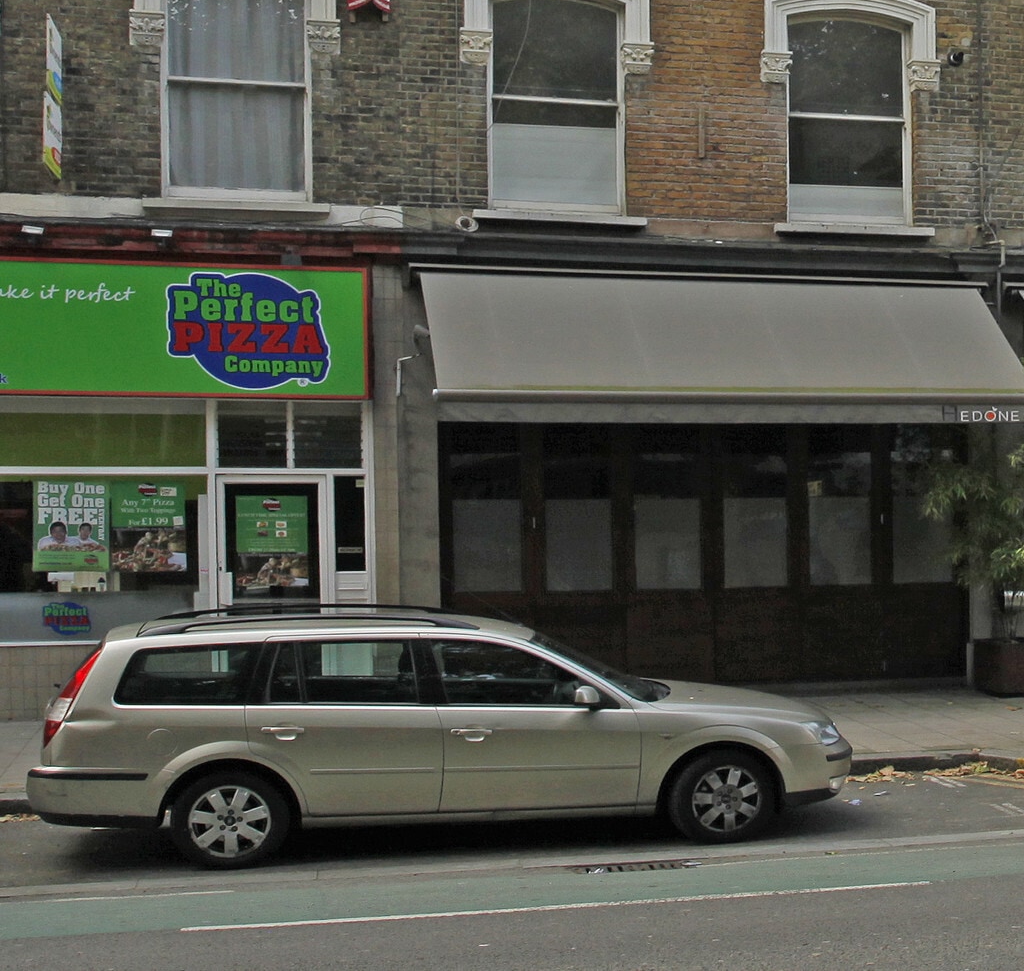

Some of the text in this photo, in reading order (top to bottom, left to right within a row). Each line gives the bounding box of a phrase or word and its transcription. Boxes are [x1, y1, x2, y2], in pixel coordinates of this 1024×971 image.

[40, 284, 59, 299] it
[65, 282, 136, 303] perfect
[196, 278, 242, 297] The
[173, 290, 315, 323] Perfect
[173, 322, 324, 354] PIZZA
[224, 355, 324, 377] Company
[37, 481, 105, 494] Buy One
[37, 494, 105, 508] Get One
[121, 499, 139, 508] Any
[37, 507, 98, 525] FREE
[141, 517, 169, 526] £1.99
[44, 607, 88, 617] Perfect
